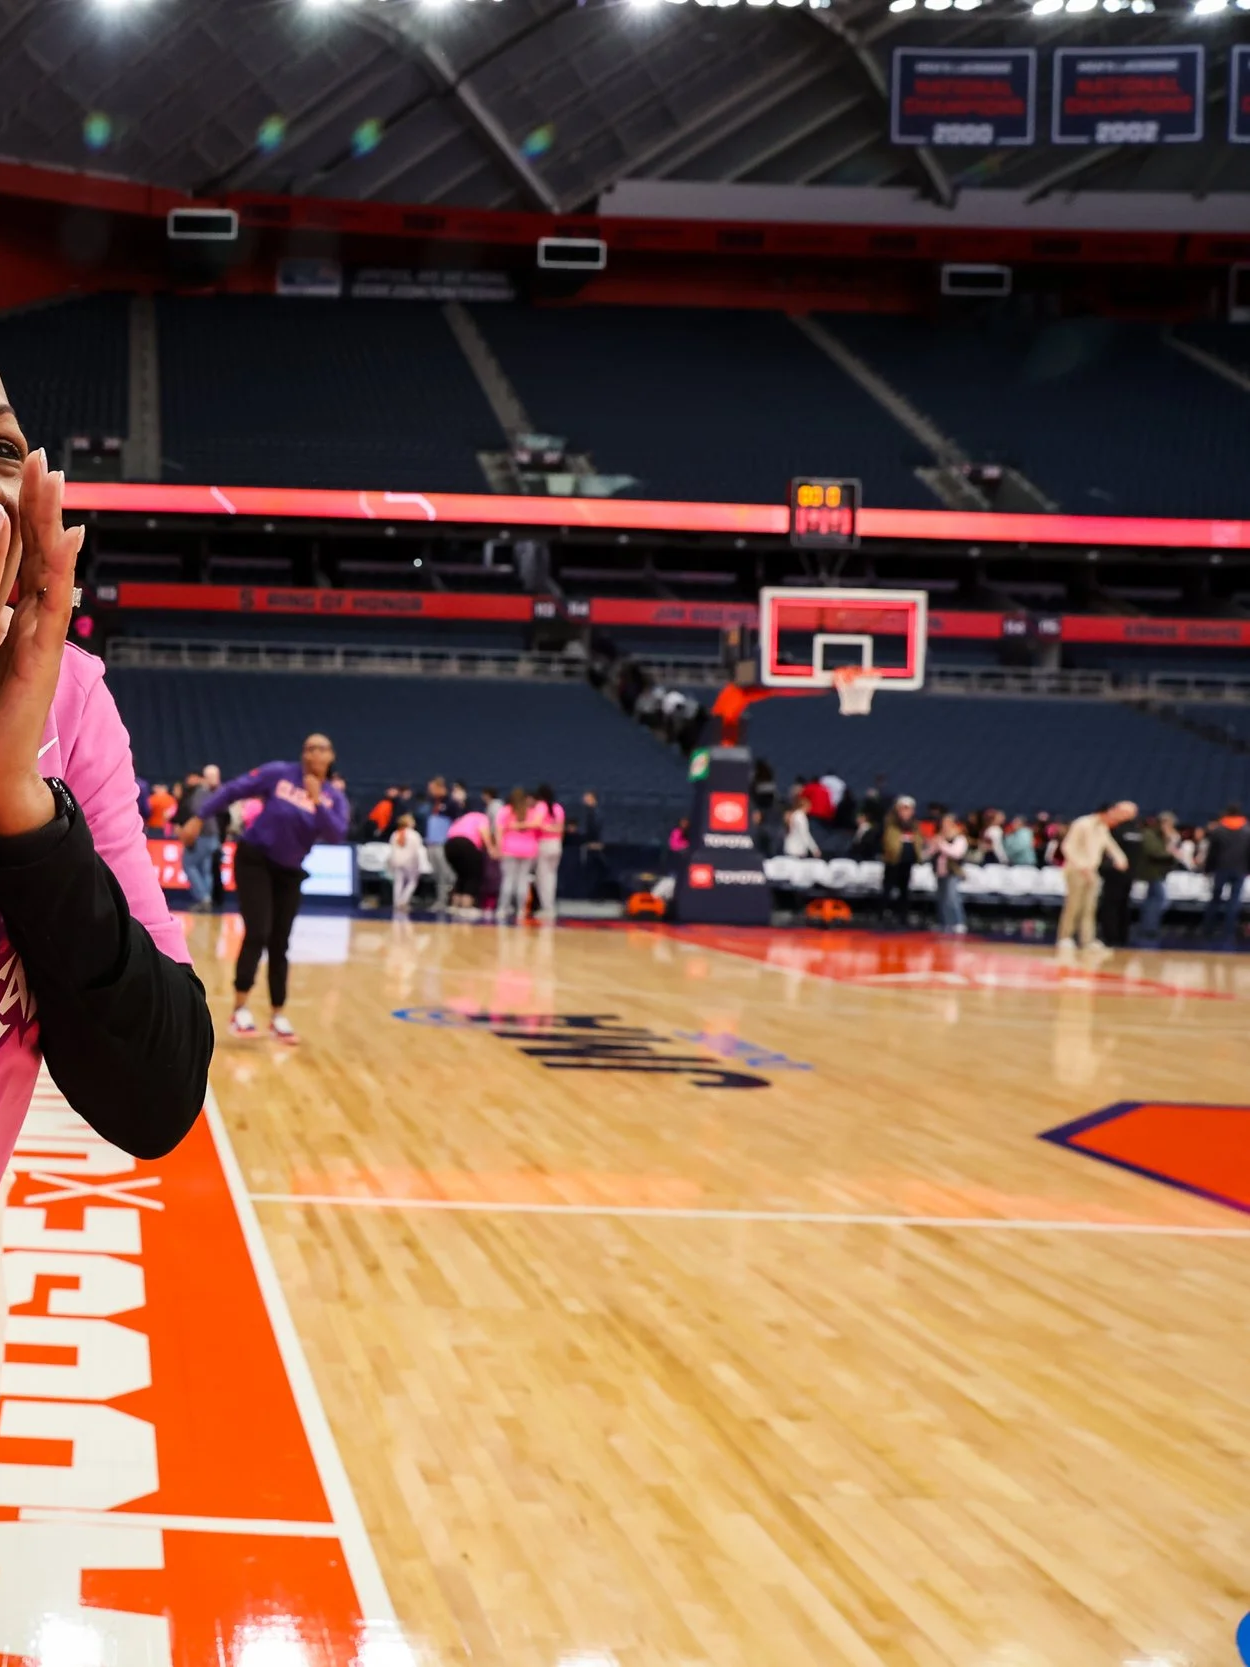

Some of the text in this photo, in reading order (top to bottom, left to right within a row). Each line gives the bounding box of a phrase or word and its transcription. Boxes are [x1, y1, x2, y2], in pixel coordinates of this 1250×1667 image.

[932, 121, 994, 144] 2000
[1095, 120, 1160, 143] 2002
[352, 593, 422, 611] HONOR
[703, 833, 754, 849] TOYOTA
[715, 869, 766, 885] TOYOTA
